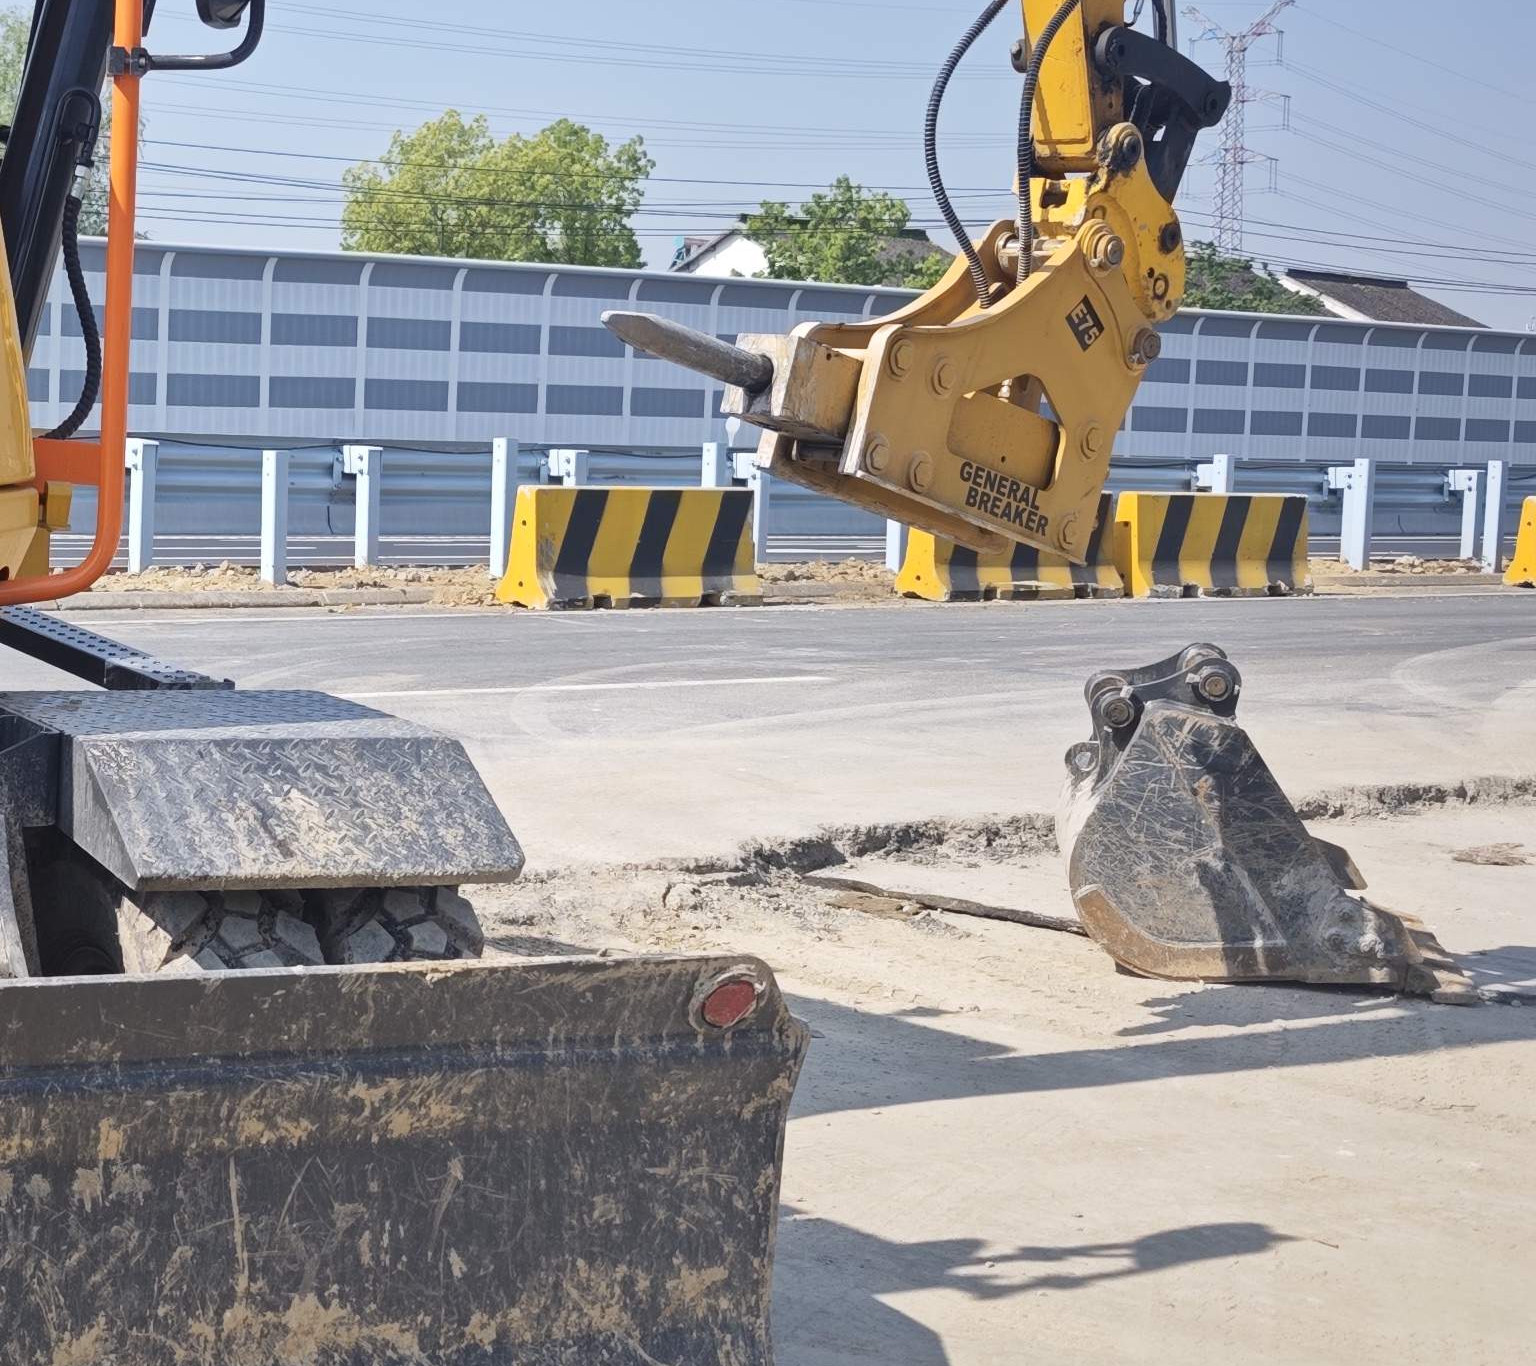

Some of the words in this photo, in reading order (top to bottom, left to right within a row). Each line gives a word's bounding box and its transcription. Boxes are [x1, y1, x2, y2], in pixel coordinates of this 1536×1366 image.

[1072, 302, 1099, 346] E75
[960, 461, 1040, 511] GENERAL
[965, 487, 1049, 537] BREAKER
